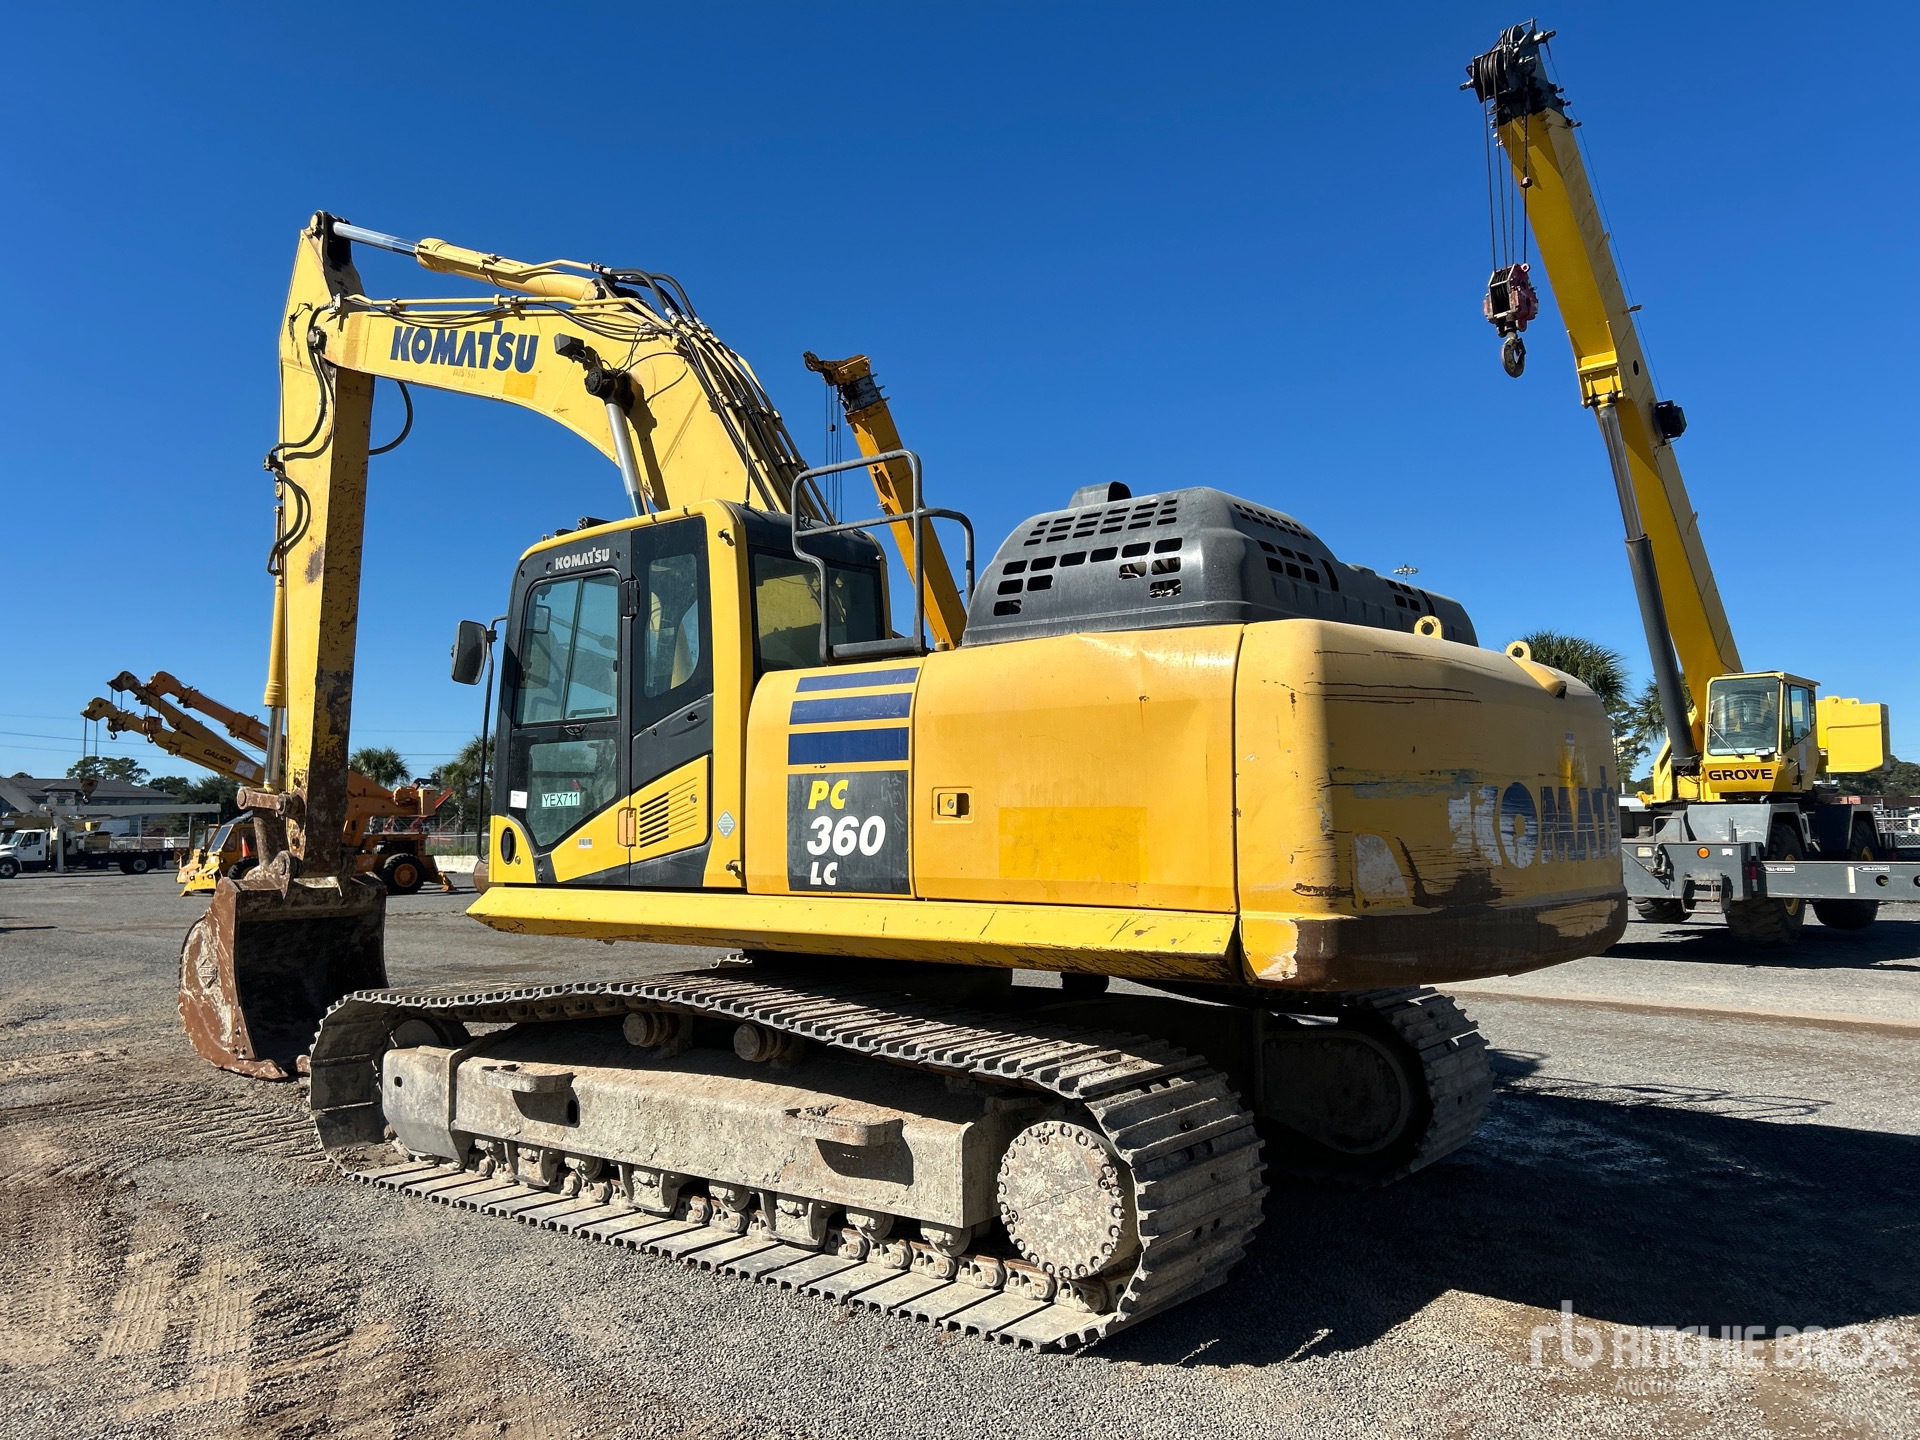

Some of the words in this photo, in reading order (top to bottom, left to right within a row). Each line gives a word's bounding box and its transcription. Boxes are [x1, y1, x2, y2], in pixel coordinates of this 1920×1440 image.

[390, 320, 539, 373] KOMATSU
[555, 547, 610, 570] KOMATSU
[203, 748, 234, 764] GALION
[1708, 769, 1774, 781] GROVE
[543, 793, 579, 806] YEX711
[807, 779, 849, 810] PC
[806, 815, 886, 857] 360
[809, 861, 838, 886] LC
